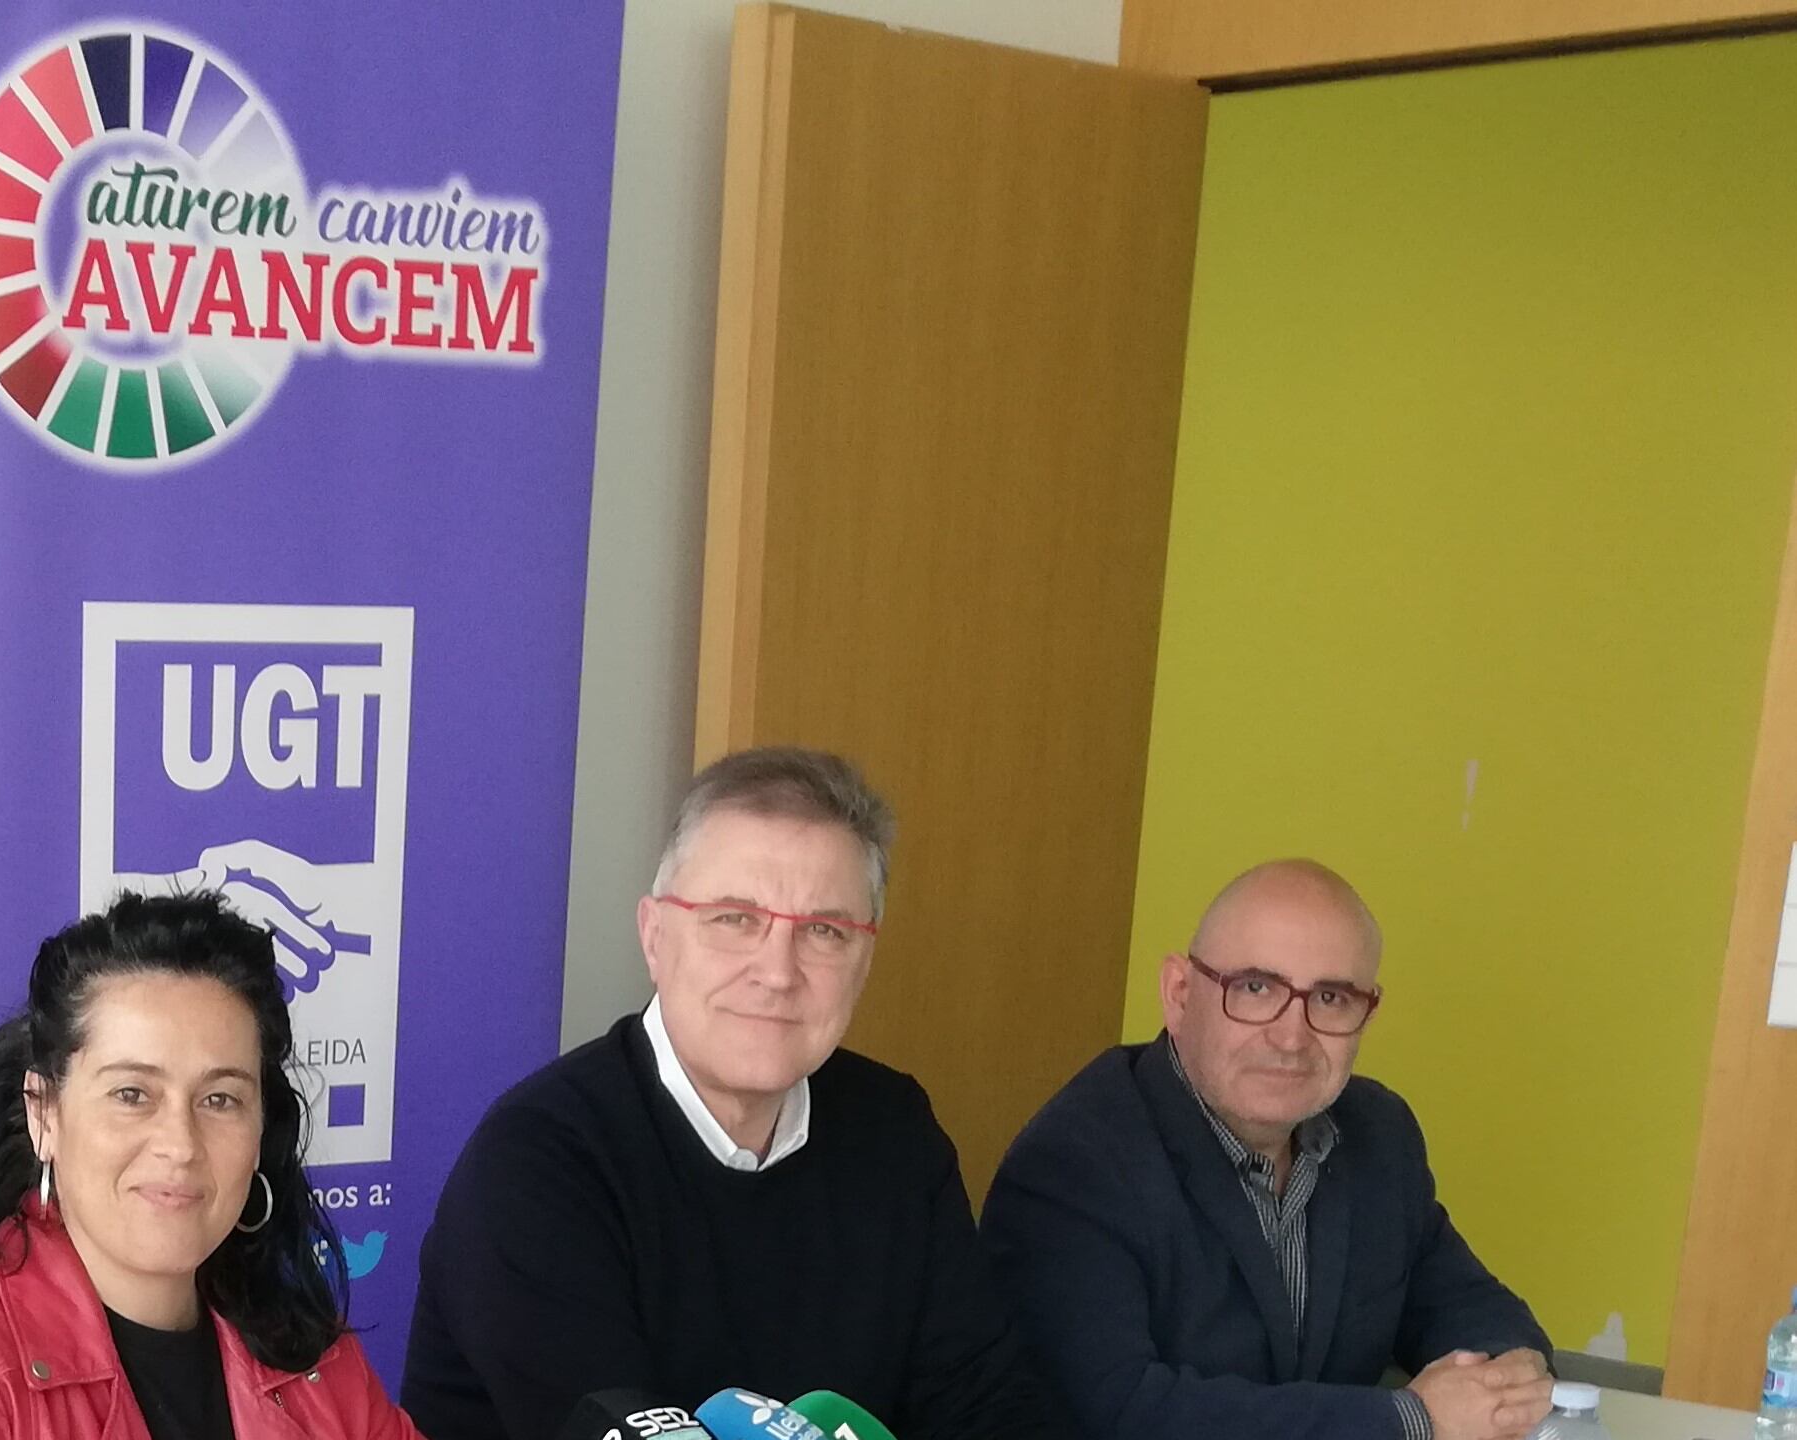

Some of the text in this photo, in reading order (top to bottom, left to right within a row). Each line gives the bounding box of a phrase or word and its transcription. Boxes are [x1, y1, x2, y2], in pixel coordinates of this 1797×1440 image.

[86, 161, 541, 256] aturem canviem
[62, 237, 539, 354] AVANCEM
[162, 662, 382, 791] UGT
[626, 1407, 699, 1438] SER
